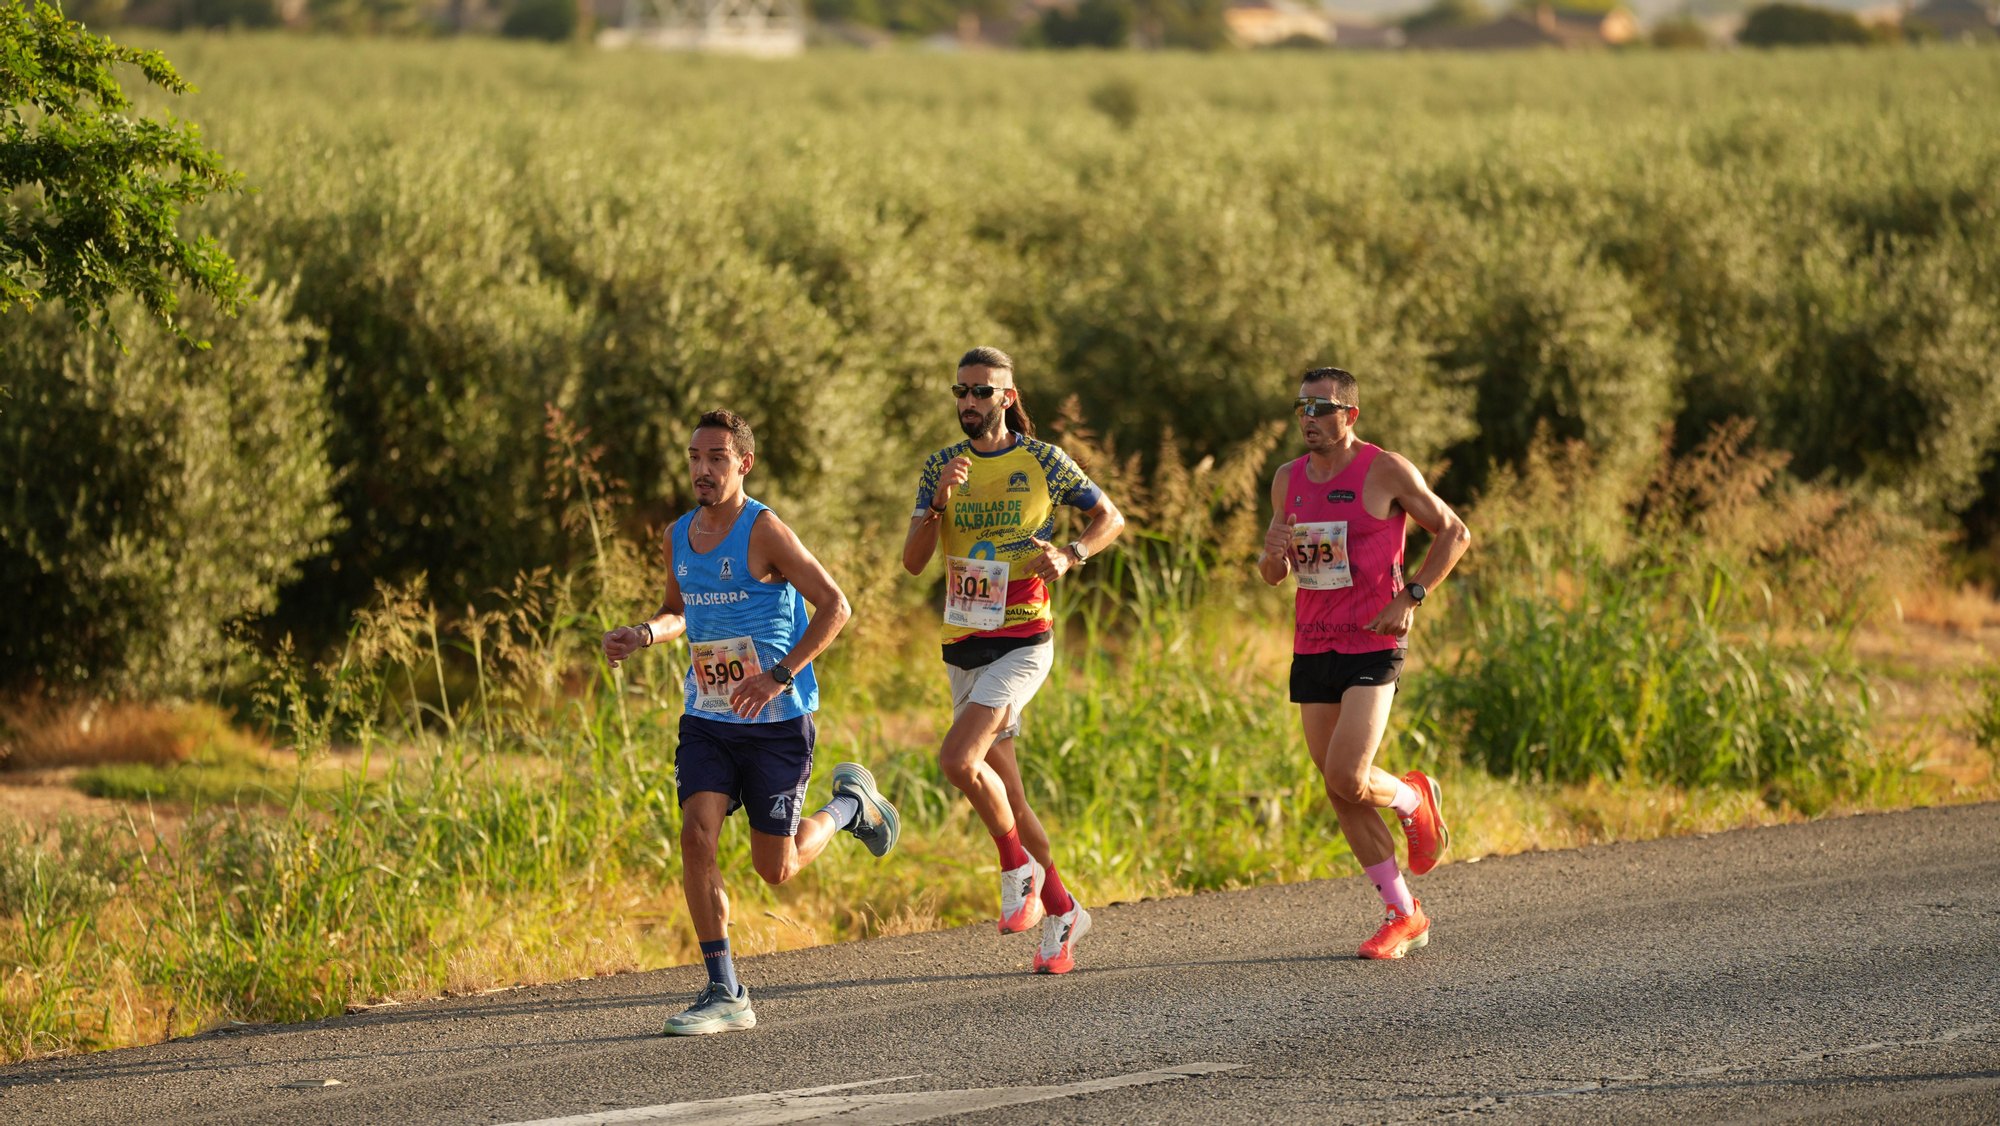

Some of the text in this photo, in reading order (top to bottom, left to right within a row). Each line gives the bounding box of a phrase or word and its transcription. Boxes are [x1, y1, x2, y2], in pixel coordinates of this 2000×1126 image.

[955, 500, 1022, 513] CANILLAS DE
[954, 512, 1021, 528] ALBAIDA
[1296, 543, 1334, 564] 573
[955, 575, 990, 599] 301
[703, 660, 745, 686] 590
